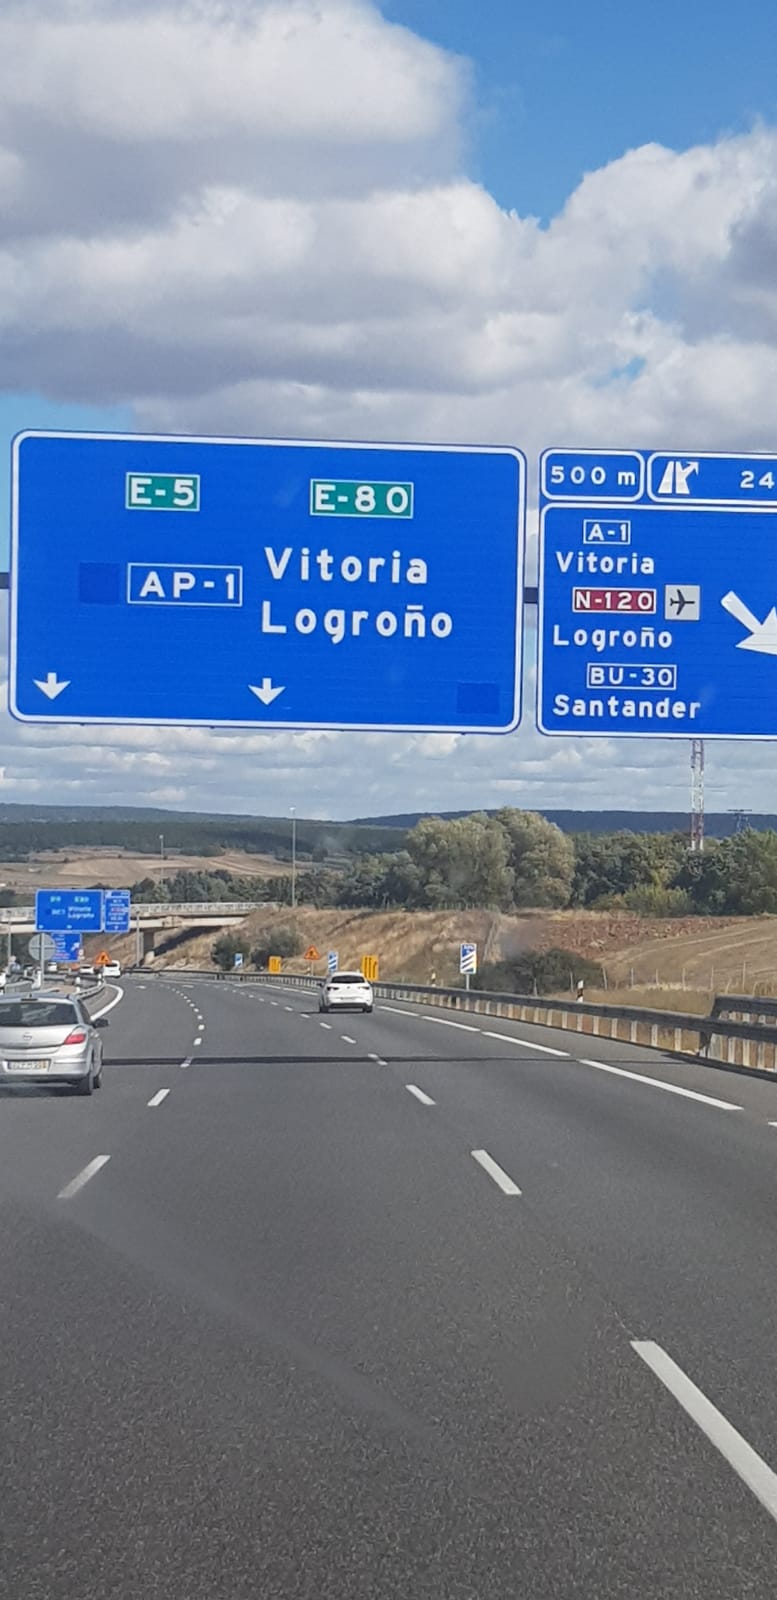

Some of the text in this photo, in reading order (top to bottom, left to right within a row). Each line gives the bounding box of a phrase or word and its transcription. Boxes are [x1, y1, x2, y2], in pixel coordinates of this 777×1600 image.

[551, 465, 637, 486] 500 m
[740, 470, 775, 489] 24
[131, 477, 194, 506] E-5
[315, 485, 409, 514] E-80
[588, 523, 627, 541] A-1
[265, 547, 427, 584] Vitoria
[556, 551, 655, 574] Vitoria
[139, 571, 235, 600] AP-1
[575, 591, 654, 611] N-120
[262, 600, 453, 645] Logroño
[553, 624, 673, 653] Logroño
[590, 667, 673, 686] BU-30
[552, 694, 701, 719] Santander
